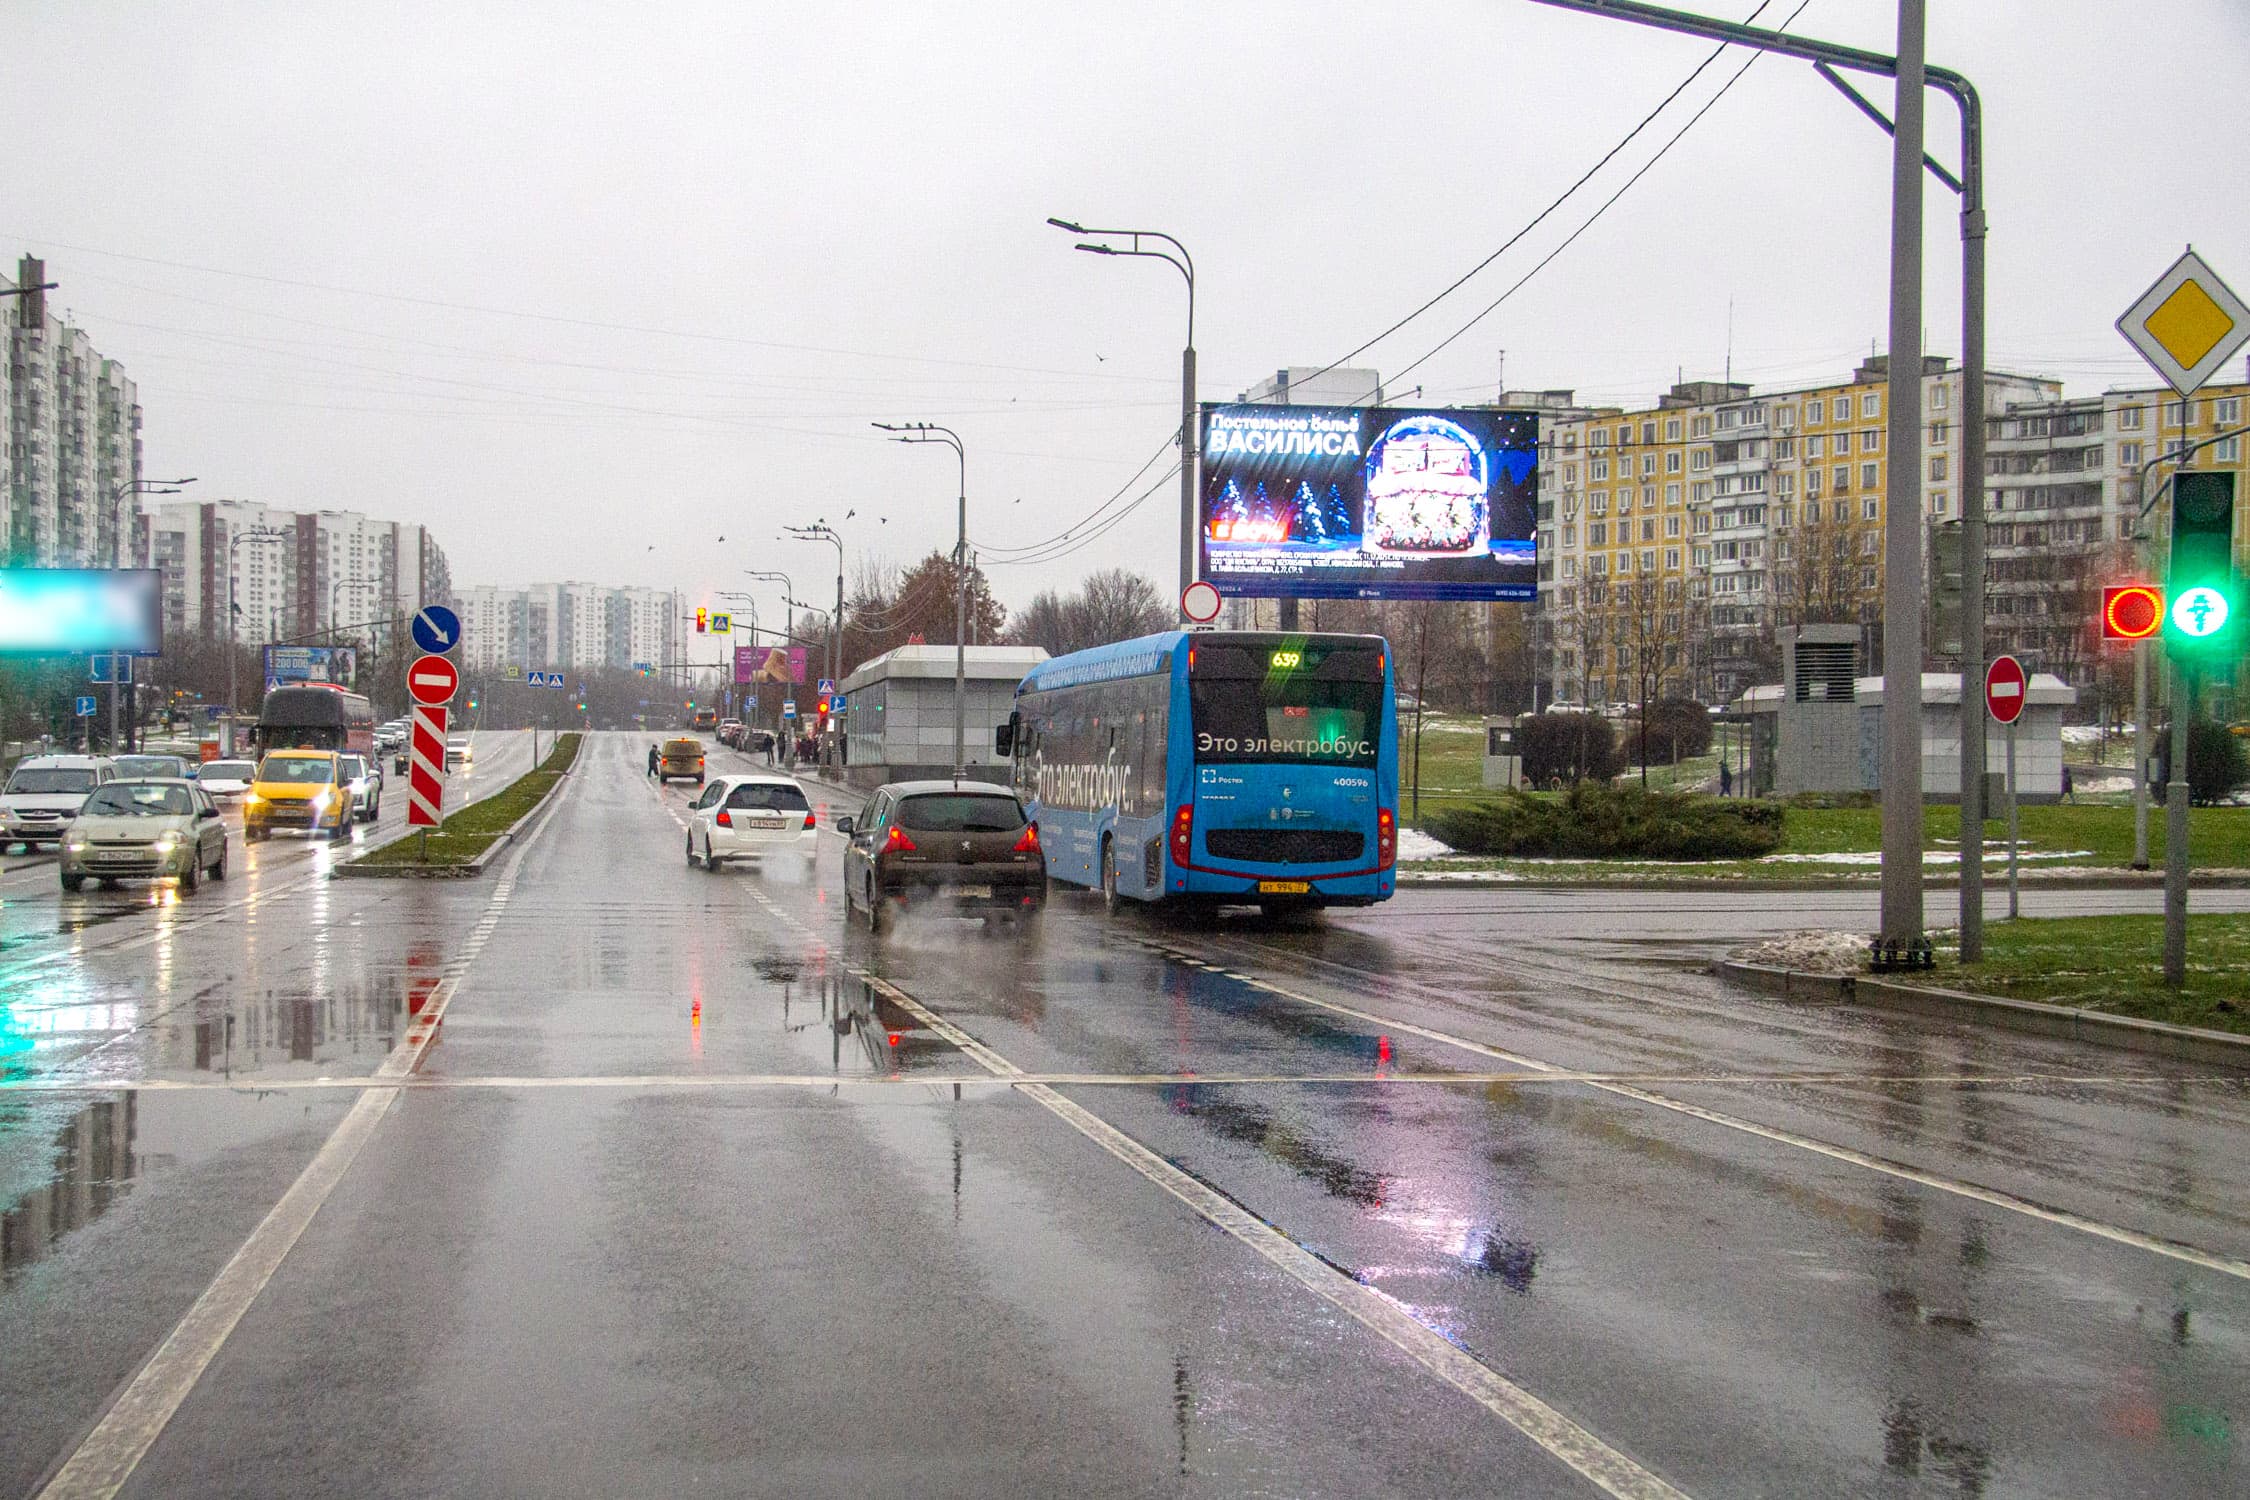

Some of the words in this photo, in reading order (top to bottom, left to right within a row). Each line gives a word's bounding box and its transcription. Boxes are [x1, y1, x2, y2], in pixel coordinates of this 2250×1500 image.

[1210, 413, 1308, 431] Постельное
[1310, 415, 1360, 433] бельё
[1209, 429, 1361, 456] ВАСИЛИСА
[1272, 652, 1300, 668] 639
[1198, 733, 1238, 752] Это
[1244, 735, 1376, 759] электробус.
[1033, 748, 1054, 804] Это
[1055, 747, 1134, 826] электробус.
[1333, 778, 1369, 787] 400596
